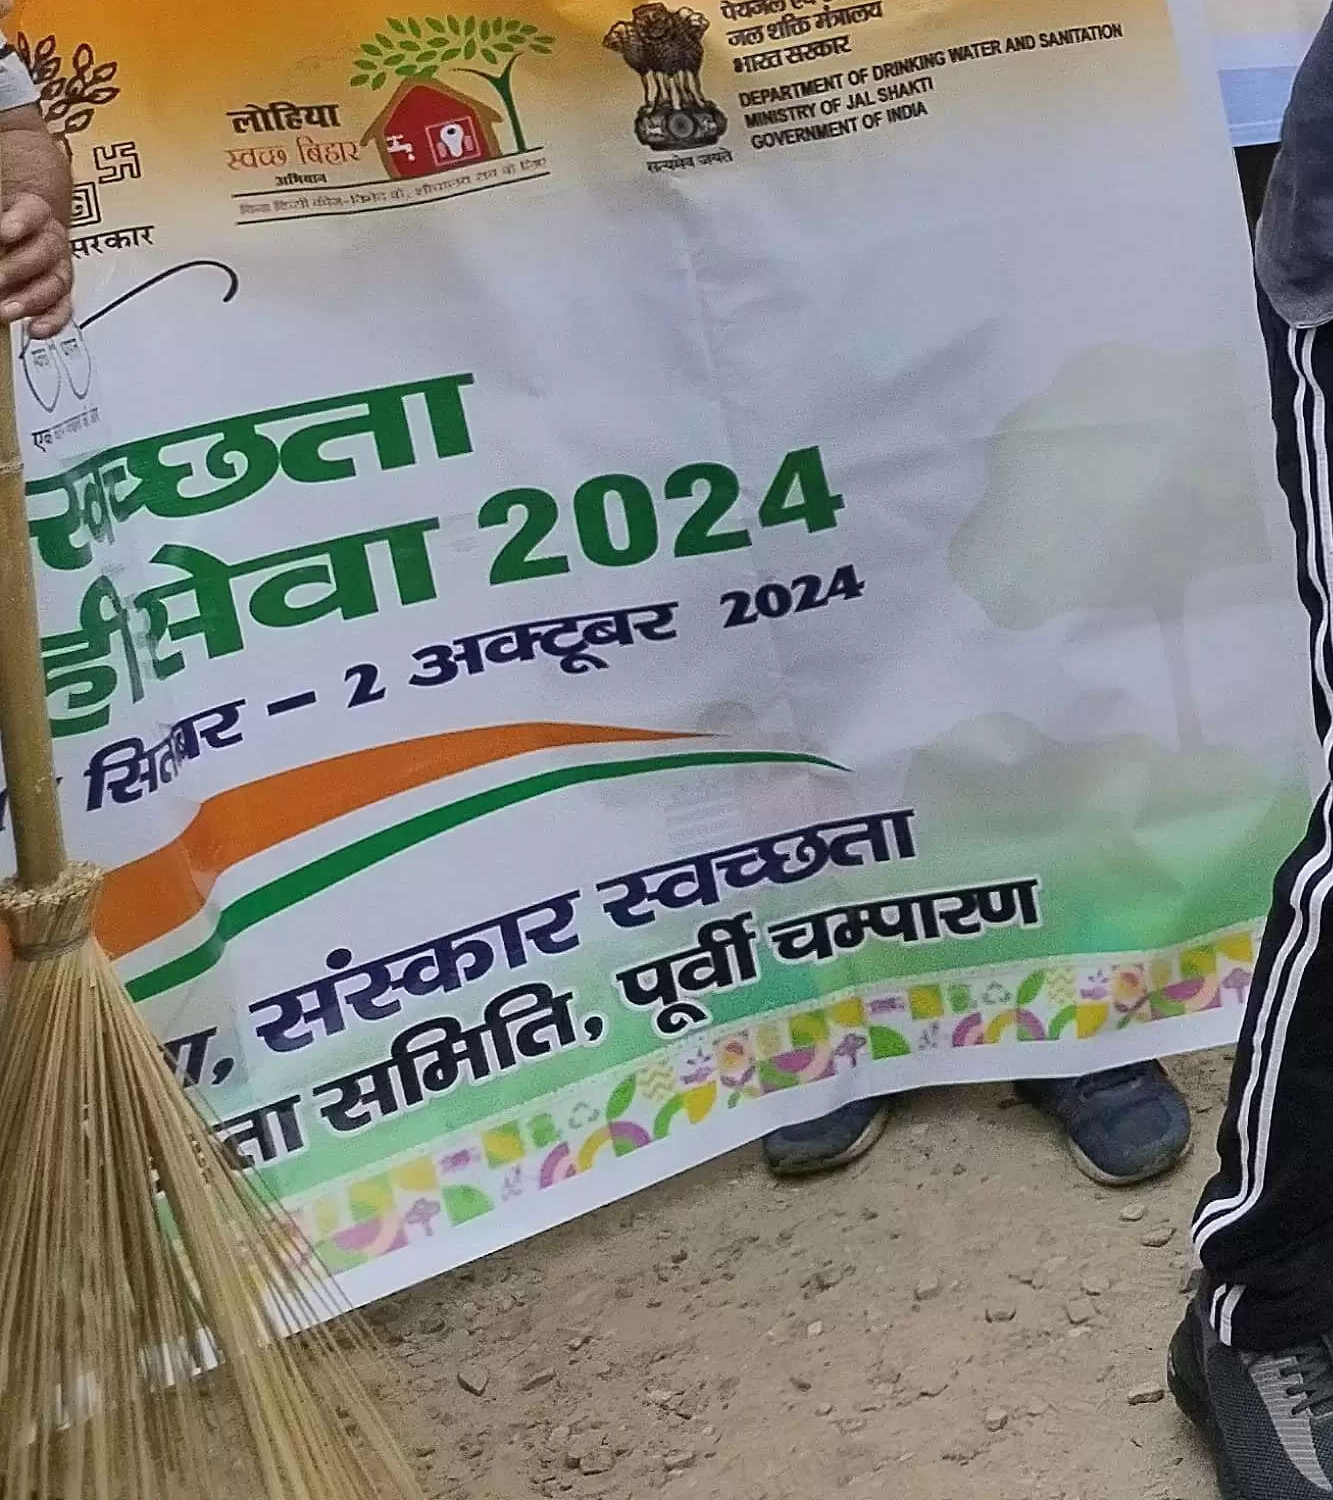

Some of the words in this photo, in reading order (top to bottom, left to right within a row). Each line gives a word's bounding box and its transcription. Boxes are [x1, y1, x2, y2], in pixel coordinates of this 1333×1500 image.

[726, 25, 765, 47] जल
[766, 12, 812, 41] शक्ति
[814, 0, 883, 30] मंत्रालय
[732, 49, 784, 74] भारत
[783, 34, 851, 65] सरकार
[739, 72, 844, 108] DEPARTMENT
[848, 67, 869, 86] OF
[872, 52, 946, 81] DRINKING
[948, 39, 1003, 63] WATER
[1005, 34, 1036, 53] AND
[1040, 22, 1123, 48] SANITATION
[226, 102, 341, 134] लोहिया
[745, 101, 825, 130] MINISTRY
[823, 96, 841, 114] OF
[847, 90, 876, 111] JAL
[878, 76, 934, 103] SHAKTI
[751, 117, 858, 150] GOVERNMENT
[862, 112, 883, 130] OF
[886, 100, 928, 124] INDIA
[225, 147, 288, 171] स्वच्छ
[296, 135, 361, 167] बिहार
[25, 372, 474, 570] स्वच्छता
[477, 445, 846, 586] 2024
[344, 663, 386, 708] 2
[409, 601, 679, 686] अक्टूबर
[720, 563, 866, 629] 2024
[249, 890, 580, 1052] संस्कार
[596, 808, 915, 928] स्वच्छता
[312, 982, 603, 1131] समिति,
[616, 912, 757, 1034] पूर्वी
[768, 878, 1038, 960] चम्पारण
